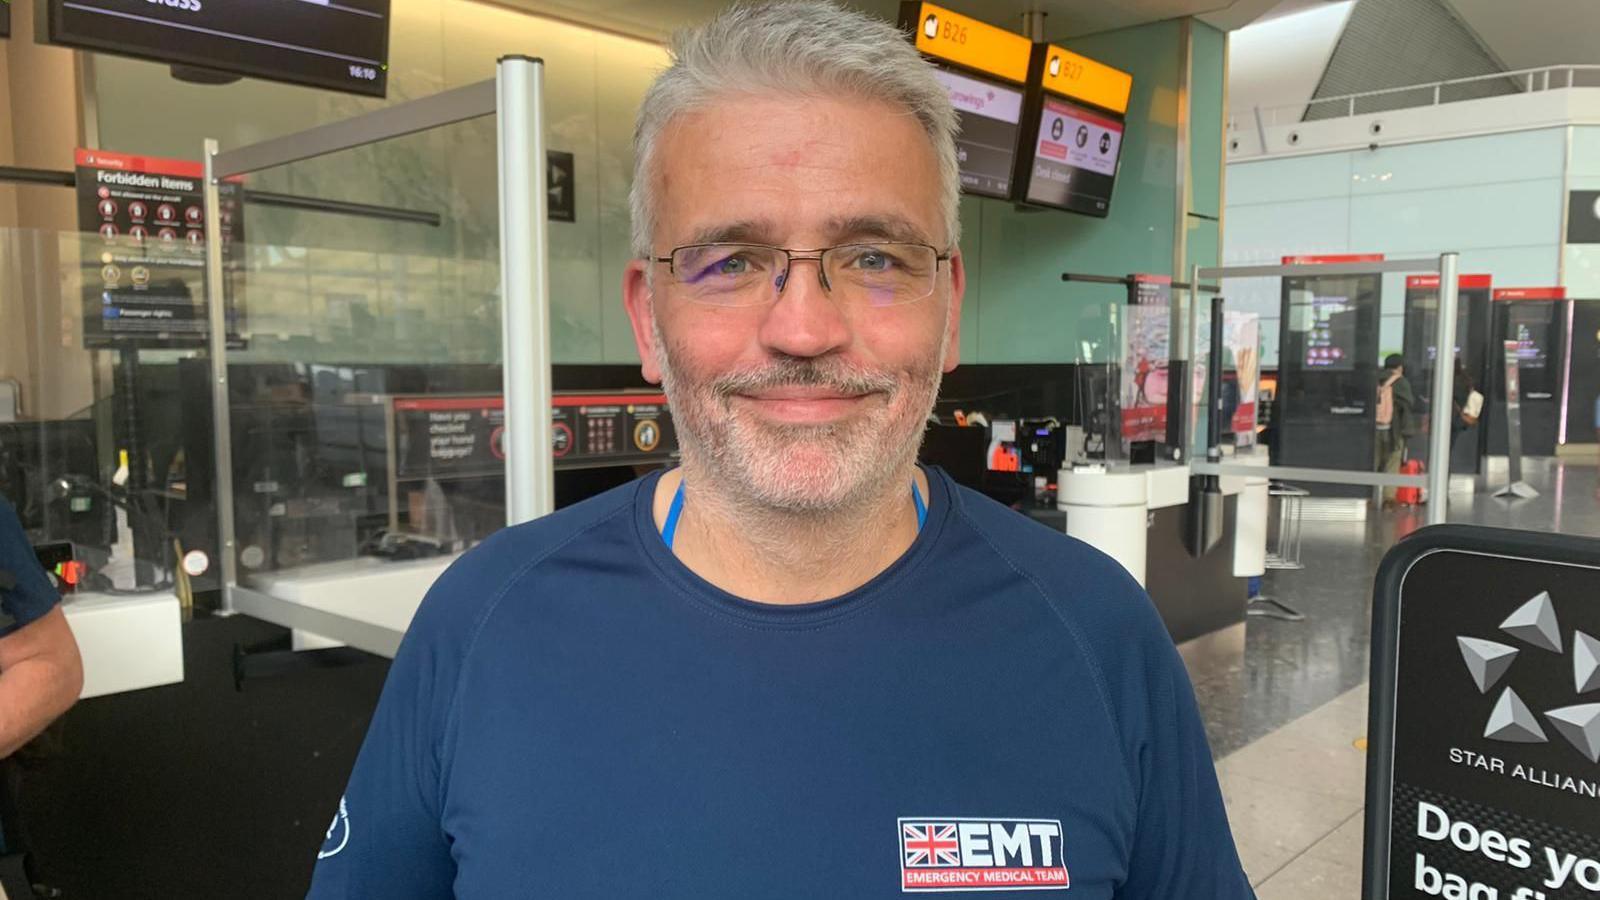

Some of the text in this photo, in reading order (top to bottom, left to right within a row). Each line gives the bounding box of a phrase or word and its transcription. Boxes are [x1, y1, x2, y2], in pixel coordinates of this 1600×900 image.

[943, 20, 968, 45] B26
[1062, 60, 1084, 81] B27
[97, 169, 160, 188] Forbidden
[429, 411, 471, 424] Have you
[1449, 747, 1600, 799] STAR ALLIAN
[957, 823, 1059, 868] EMT
[1416, 801, 1532, 869] Does
[906, 869, 1065, 884] EMERGENCY MEDICAL TEAM
